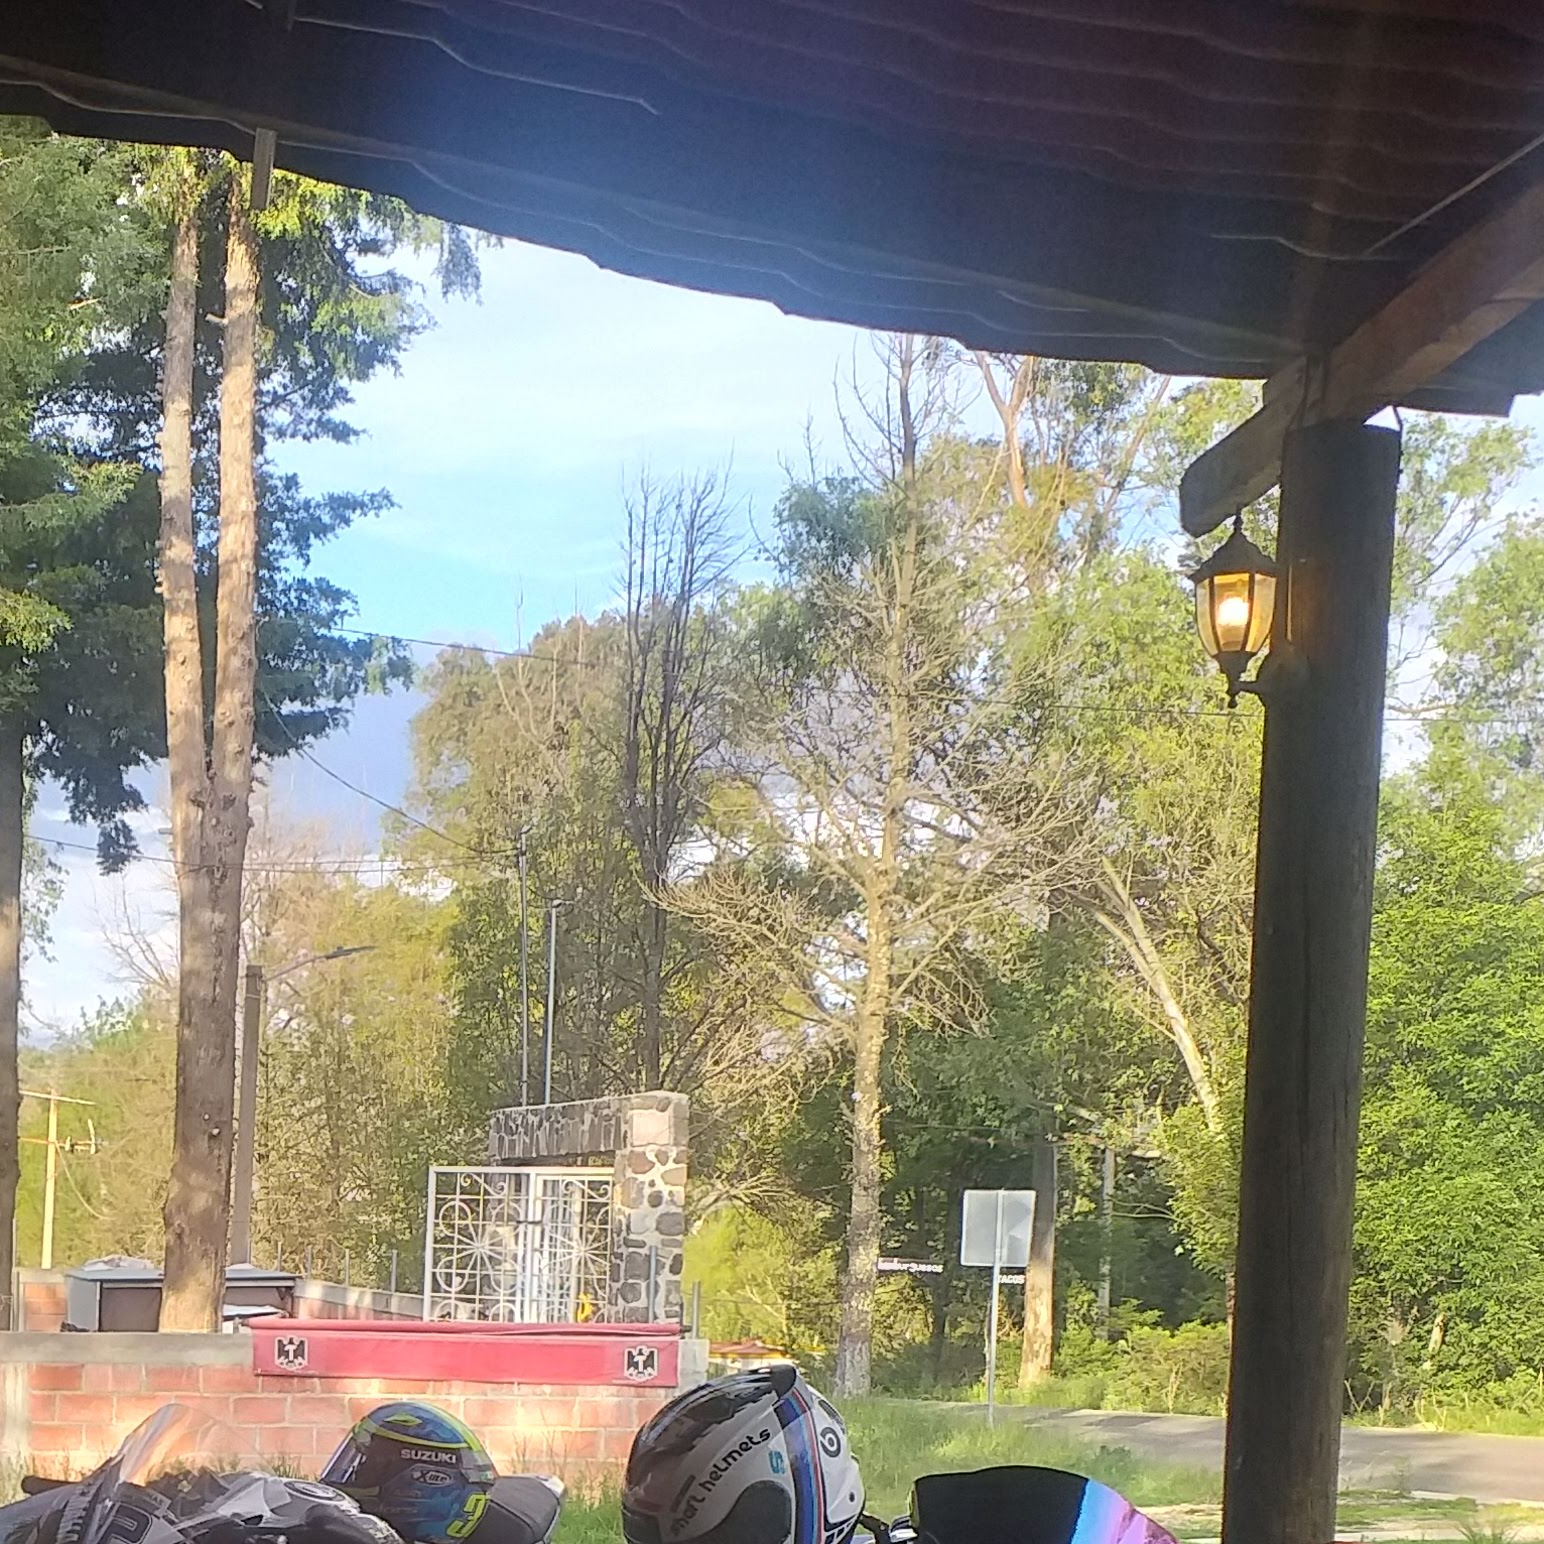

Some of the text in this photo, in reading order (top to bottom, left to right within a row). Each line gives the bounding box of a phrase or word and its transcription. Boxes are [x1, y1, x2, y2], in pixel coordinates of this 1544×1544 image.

[400, 1448, 457, 1464] SUZUKI
[698, 1428, 771, 1493] helmets
[446, 1491, 489, 1538] 3
